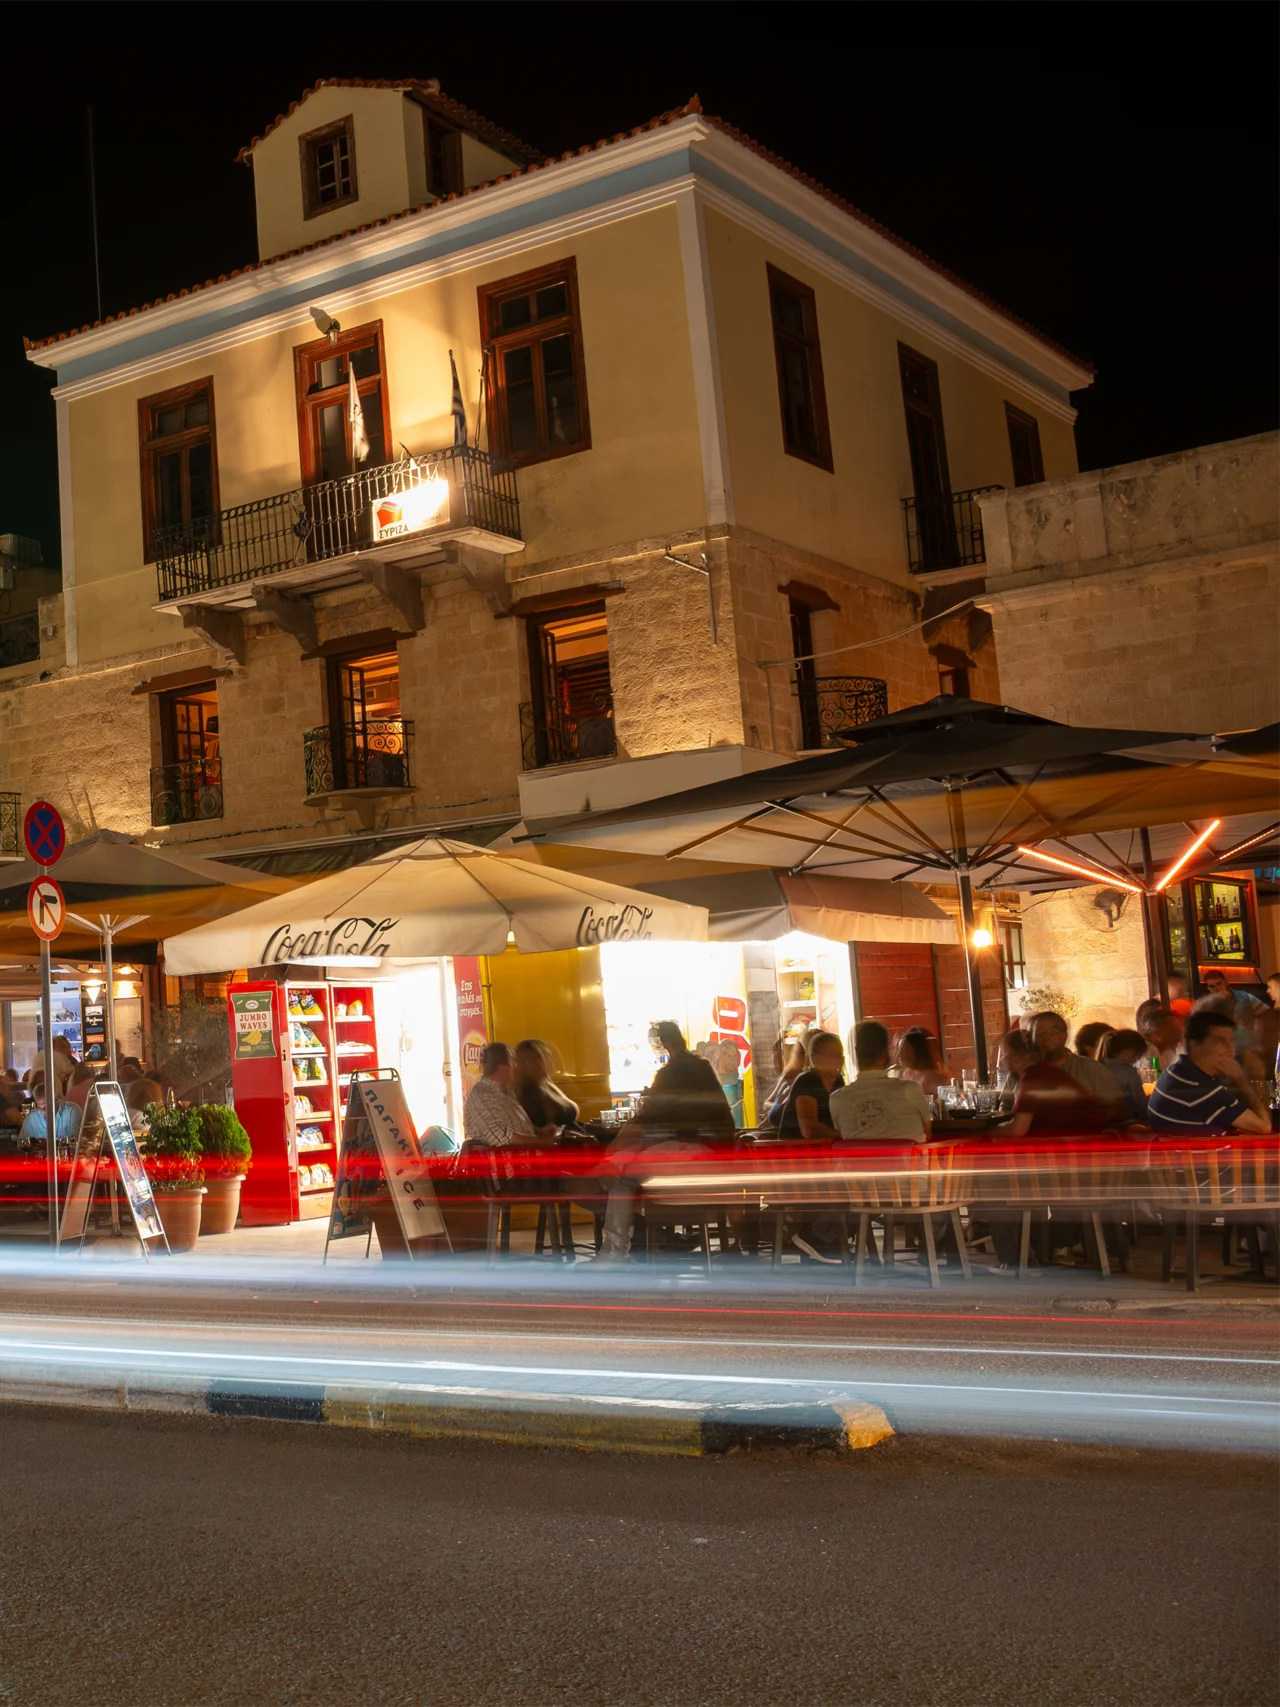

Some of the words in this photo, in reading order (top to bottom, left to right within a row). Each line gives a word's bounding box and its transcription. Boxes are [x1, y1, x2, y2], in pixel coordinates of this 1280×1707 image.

[379, 523, 410, 539] ΣΥΡΙΖΑ
[261, 917, 403, 966] Coca-Cola
[239, 1012, 268, 1023] JUMBO
[239, 1021, 269, 1031] WAVES
[395, 1168, 425, 1212] ICE
